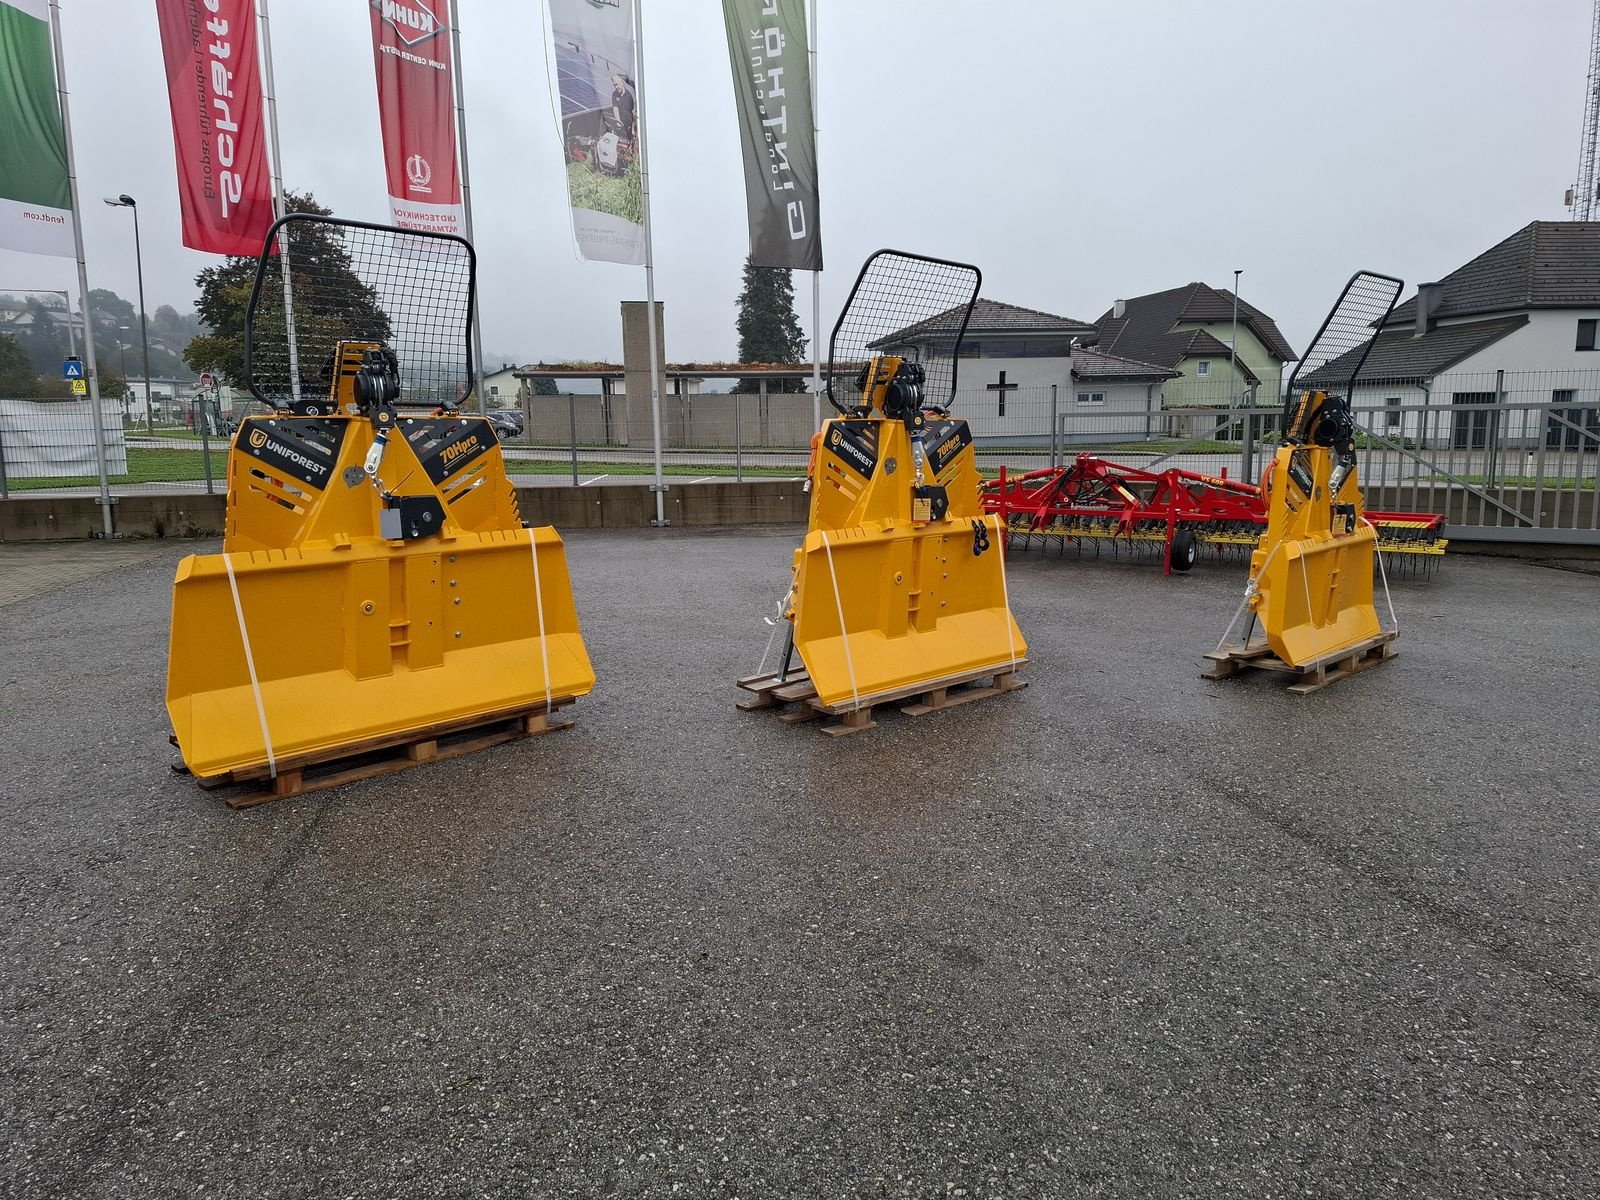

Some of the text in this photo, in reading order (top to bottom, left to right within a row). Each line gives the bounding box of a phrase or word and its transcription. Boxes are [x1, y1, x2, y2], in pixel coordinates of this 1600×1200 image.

[265, 439, 327, 476] UNIFOREST
[439, 435, 478, 464] 70Hpro
[840, 438, 874, 468] UNIFOREST
